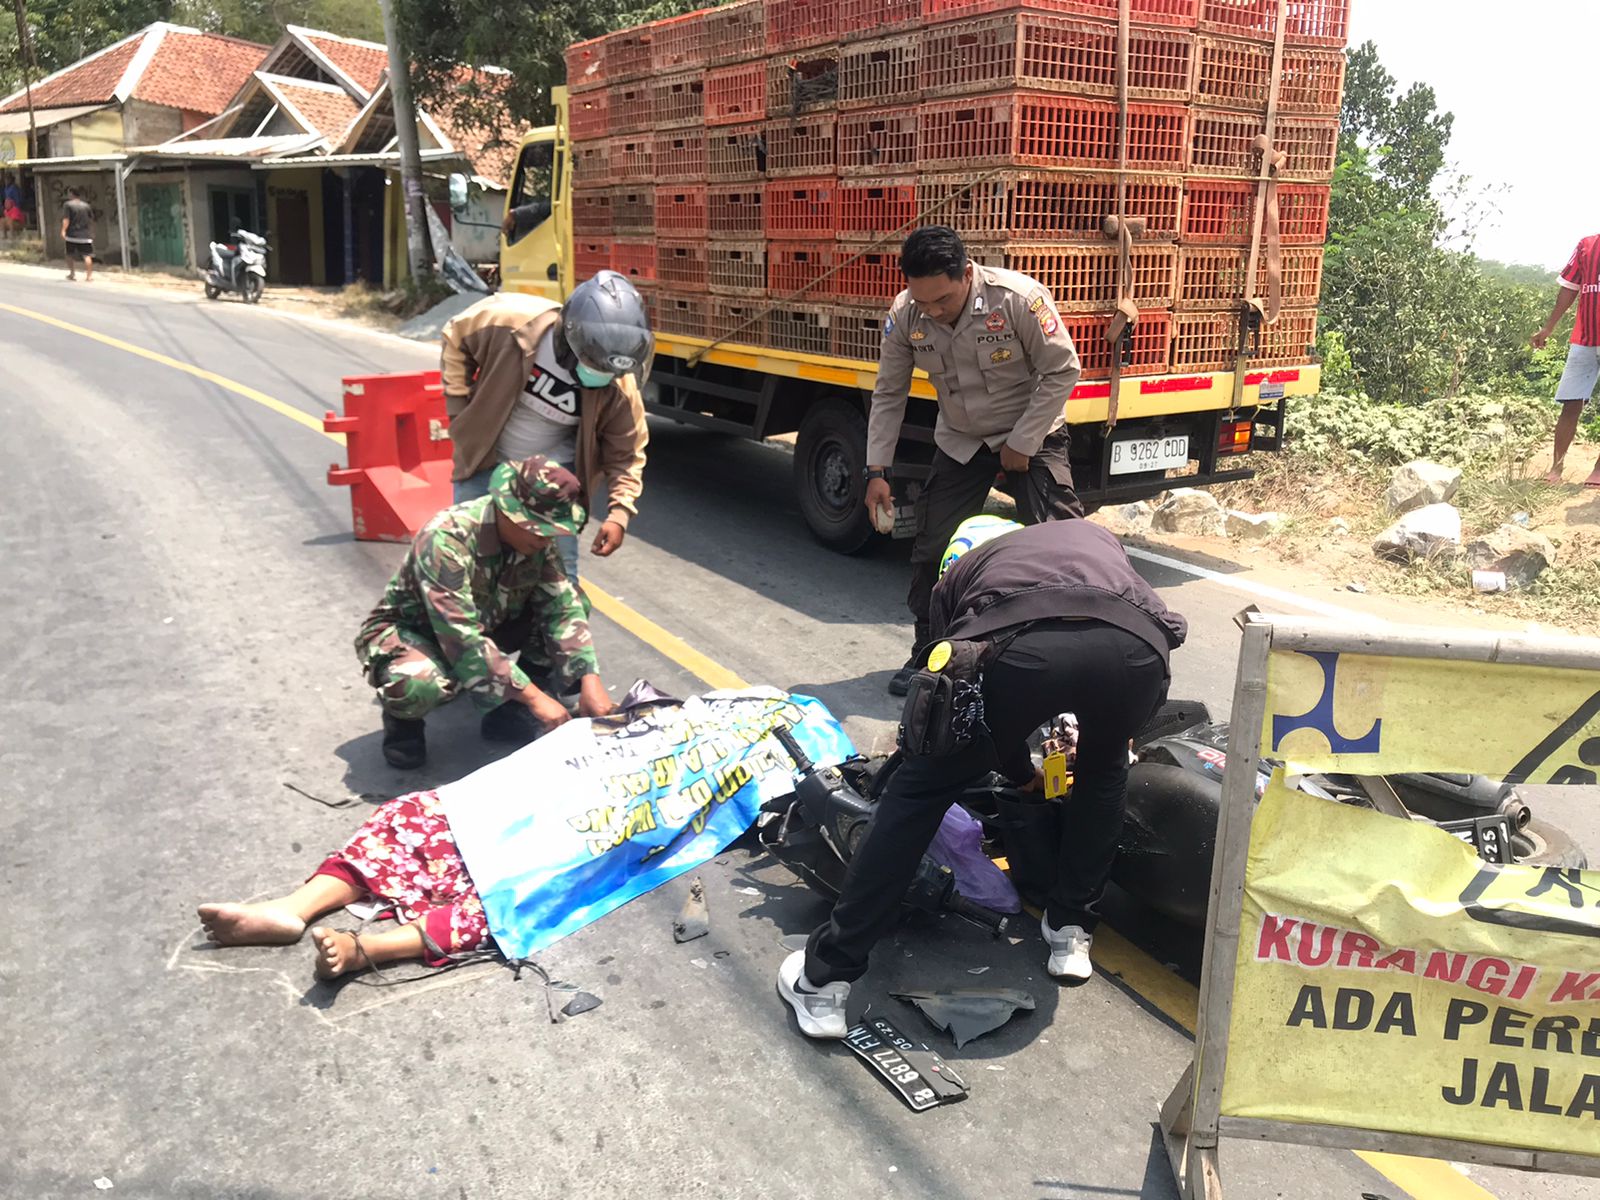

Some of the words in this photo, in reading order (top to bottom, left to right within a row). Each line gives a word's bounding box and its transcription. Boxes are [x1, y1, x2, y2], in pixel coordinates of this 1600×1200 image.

[1114, 445, 1121, 463] B
[1130, 441, 1160, 461] 9262
[1164, 439, 1186, 457] CDD
[1257, 914, 1537, 999] KURANGI
[1550, 971, 1600, 1002] K
[1286, 984, 1417, 1036] ADA
[872, 1050, 920, 1084] 6877
